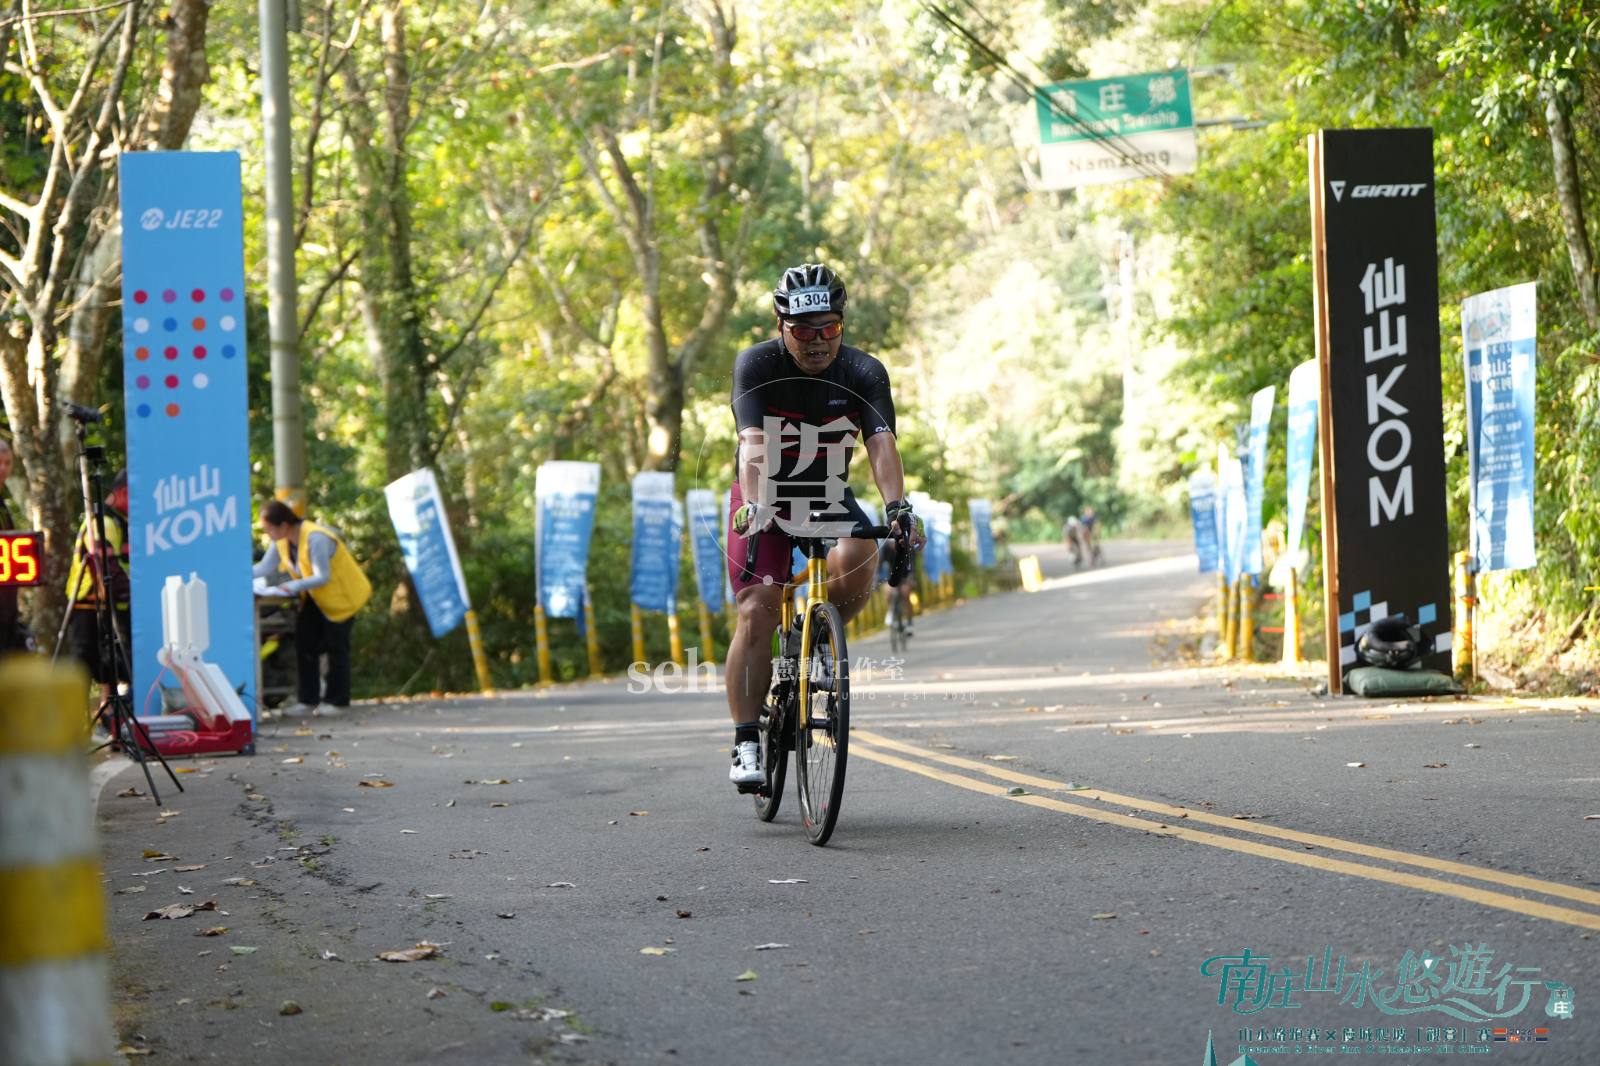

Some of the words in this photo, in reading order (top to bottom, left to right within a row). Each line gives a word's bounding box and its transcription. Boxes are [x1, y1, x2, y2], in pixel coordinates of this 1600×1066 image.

[1351, 183, 1427, 198] GIANT
[165, 209, 223, 229] JE22
[153, 464, 219, 515] 仙山
[145, 495, 237, 556] KOM
